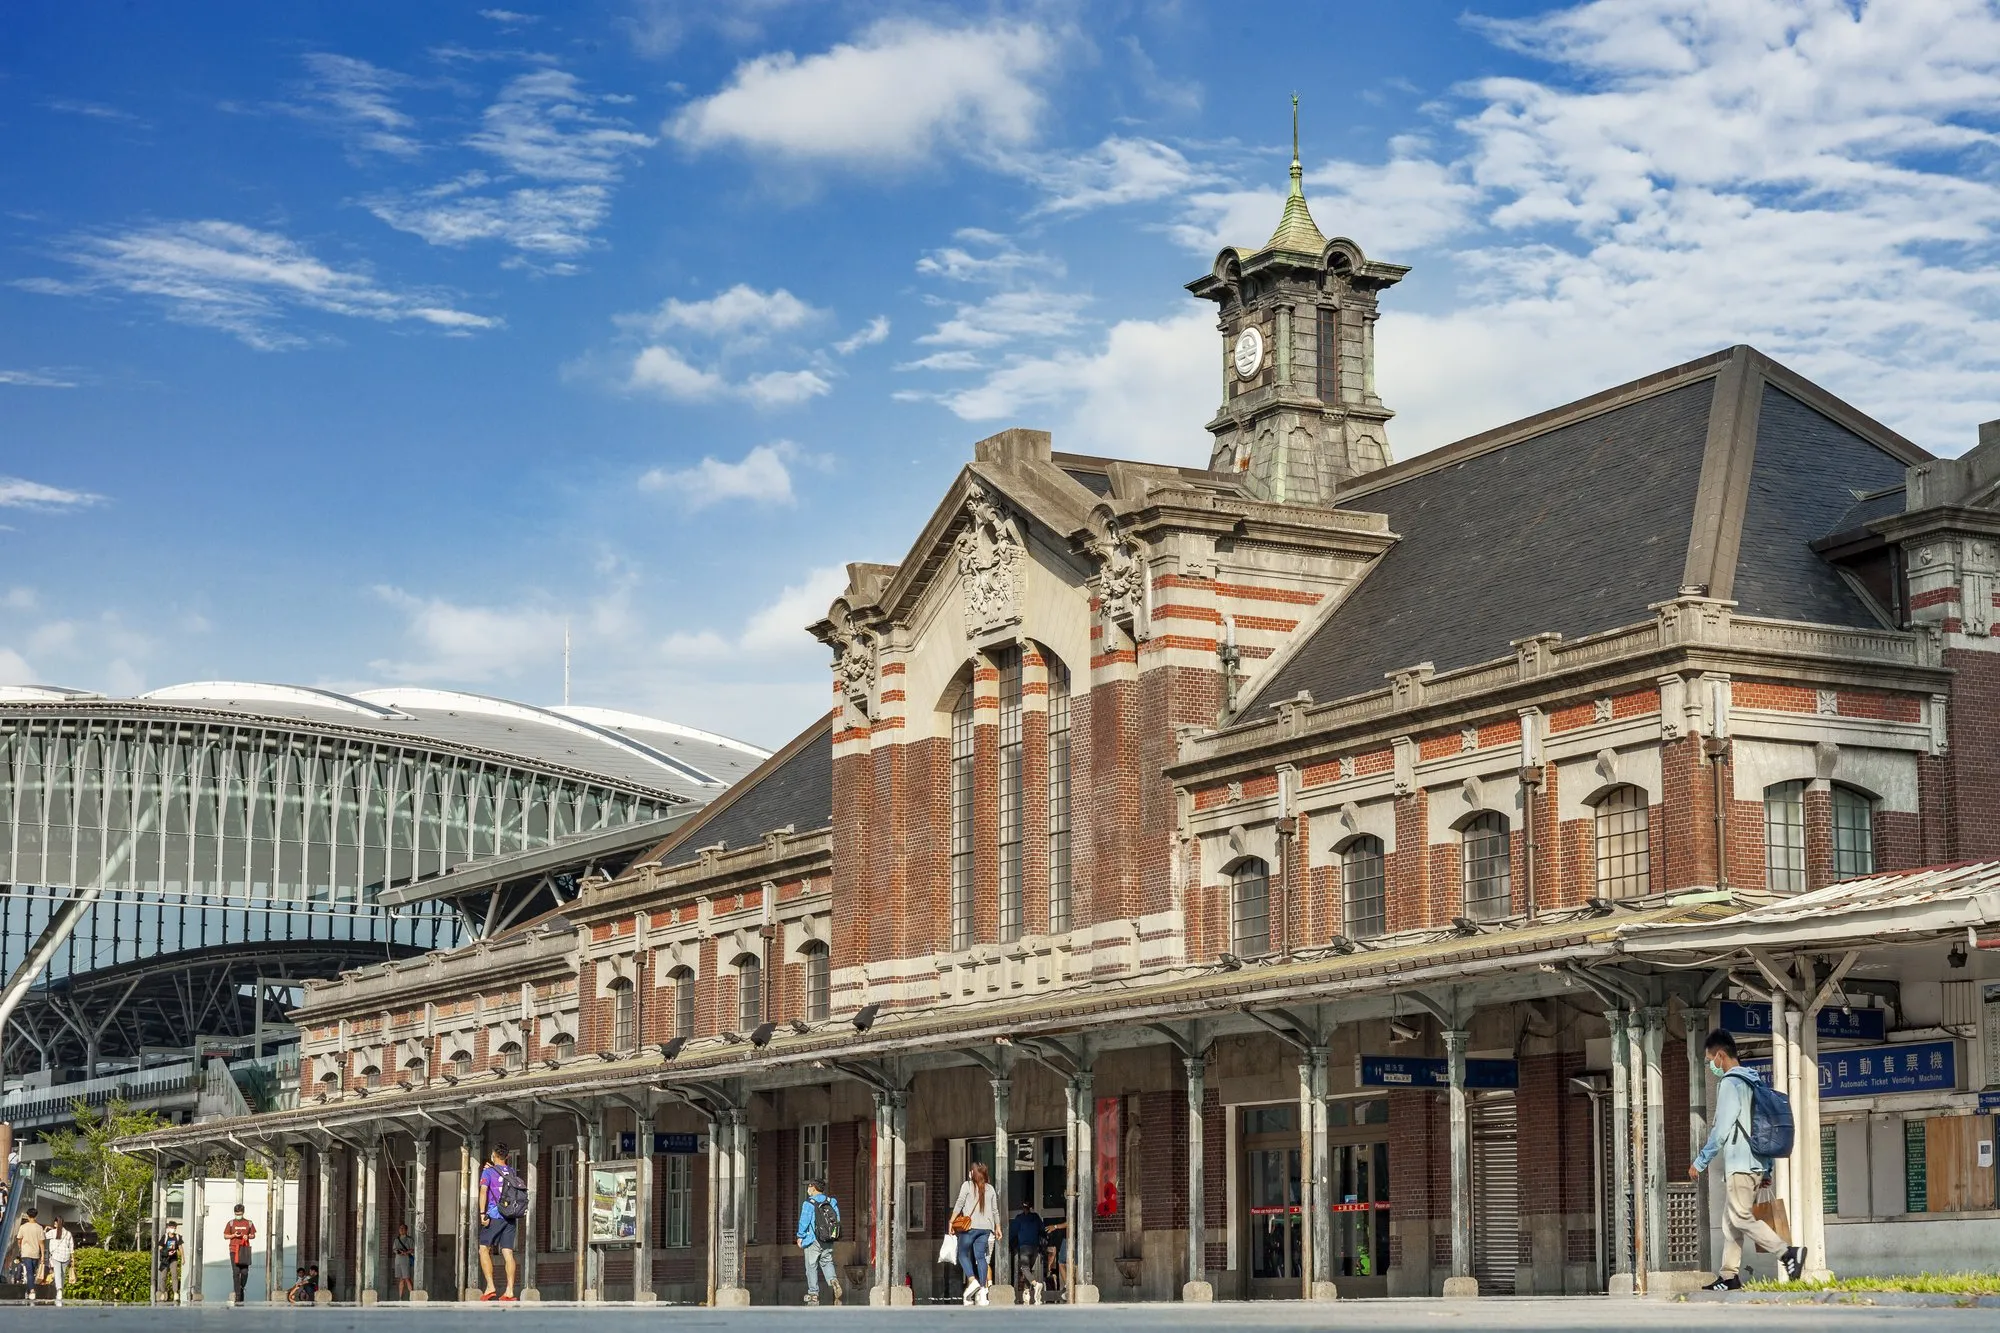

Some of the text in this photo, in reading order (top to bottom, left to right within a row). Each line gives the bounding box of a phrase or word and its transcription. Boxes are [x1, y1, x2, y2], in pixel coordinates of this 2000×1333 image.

[1838, 1051, 1943, 1077] 自動售票機
[1840, 1073, 1943, 1088] Automatic Ticket Vending Machine
